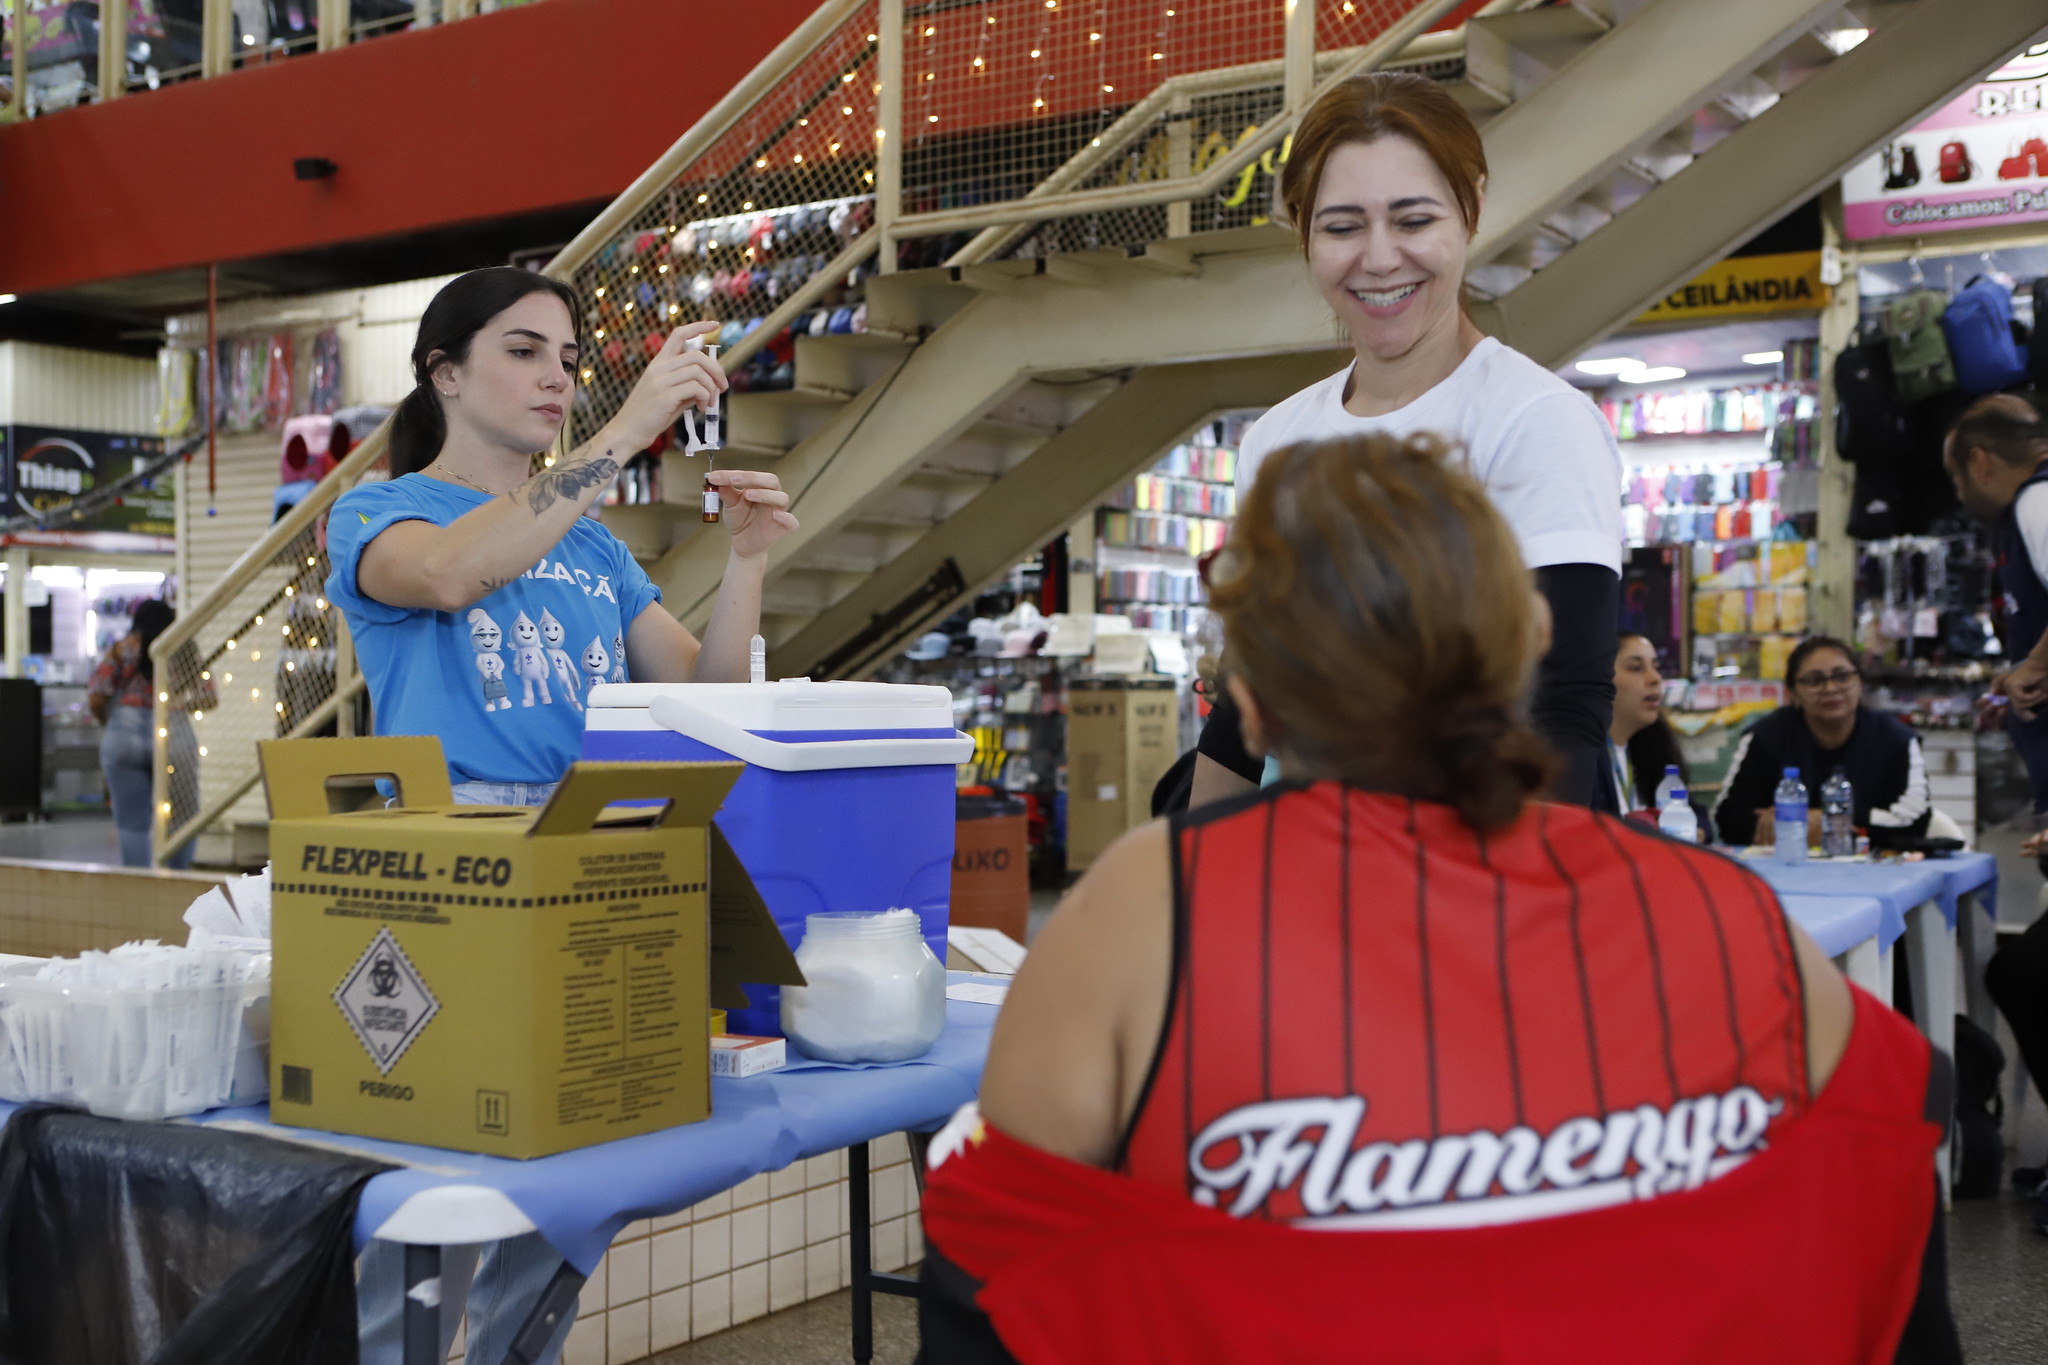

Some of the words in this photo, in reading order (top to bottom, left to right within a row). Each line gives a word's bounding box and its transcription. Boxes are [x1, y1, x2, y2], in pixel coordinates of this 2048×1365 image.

[1885, 199, 2010, 225] Colocamos:
[1665, 275, 1812, 309] CEILÂNDIA
[301, 844, 428, 881] FLEXPELL
[452, 855, 512, 887] ECO
[359, 1080, 415, 1102] PERIGO
[1189, 1085, 1776, 1218] Flamengo
